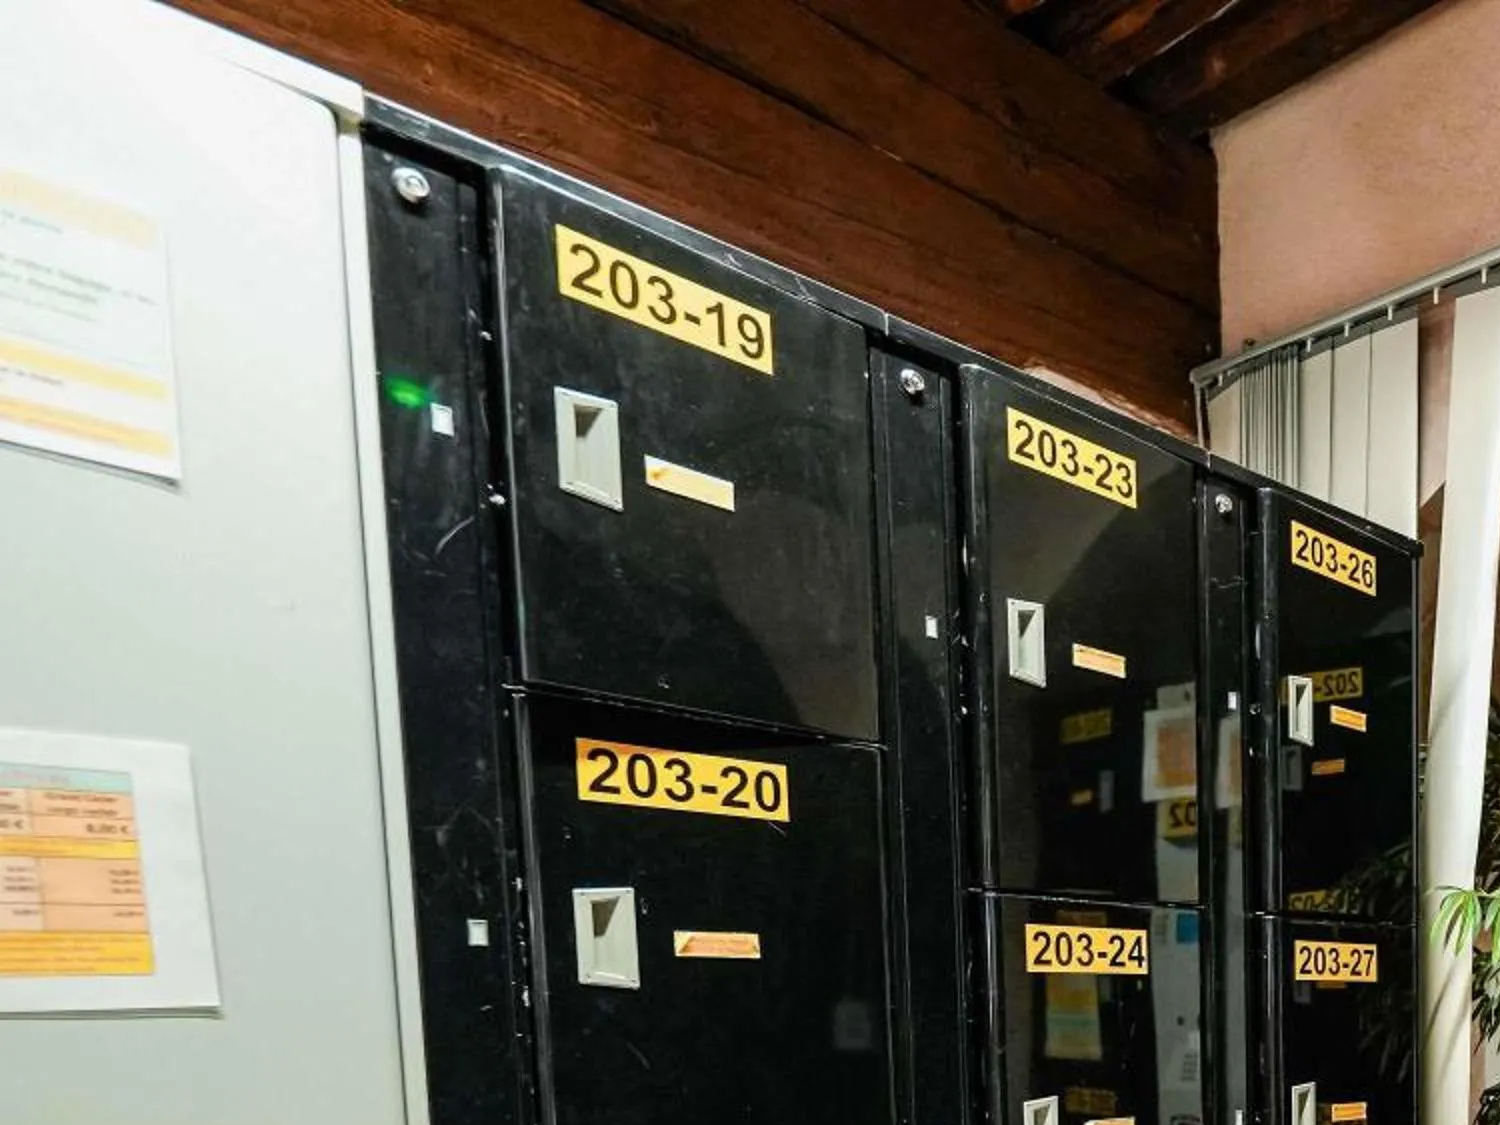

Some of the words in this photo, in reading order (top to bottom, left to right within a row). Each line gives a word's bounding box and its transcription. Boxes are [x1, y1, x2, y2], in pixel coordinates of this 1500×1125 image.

[570, 243, 764, 360] 203-19
[1015, 419, 1133, 499] 203-23
[1295, 529, 1374, 589] 203-26
[586, 747, 781, 813] 203-20
[1033, 930, 1144, 969] 203-24
[1299, 945, 1374, 977] 203-27
